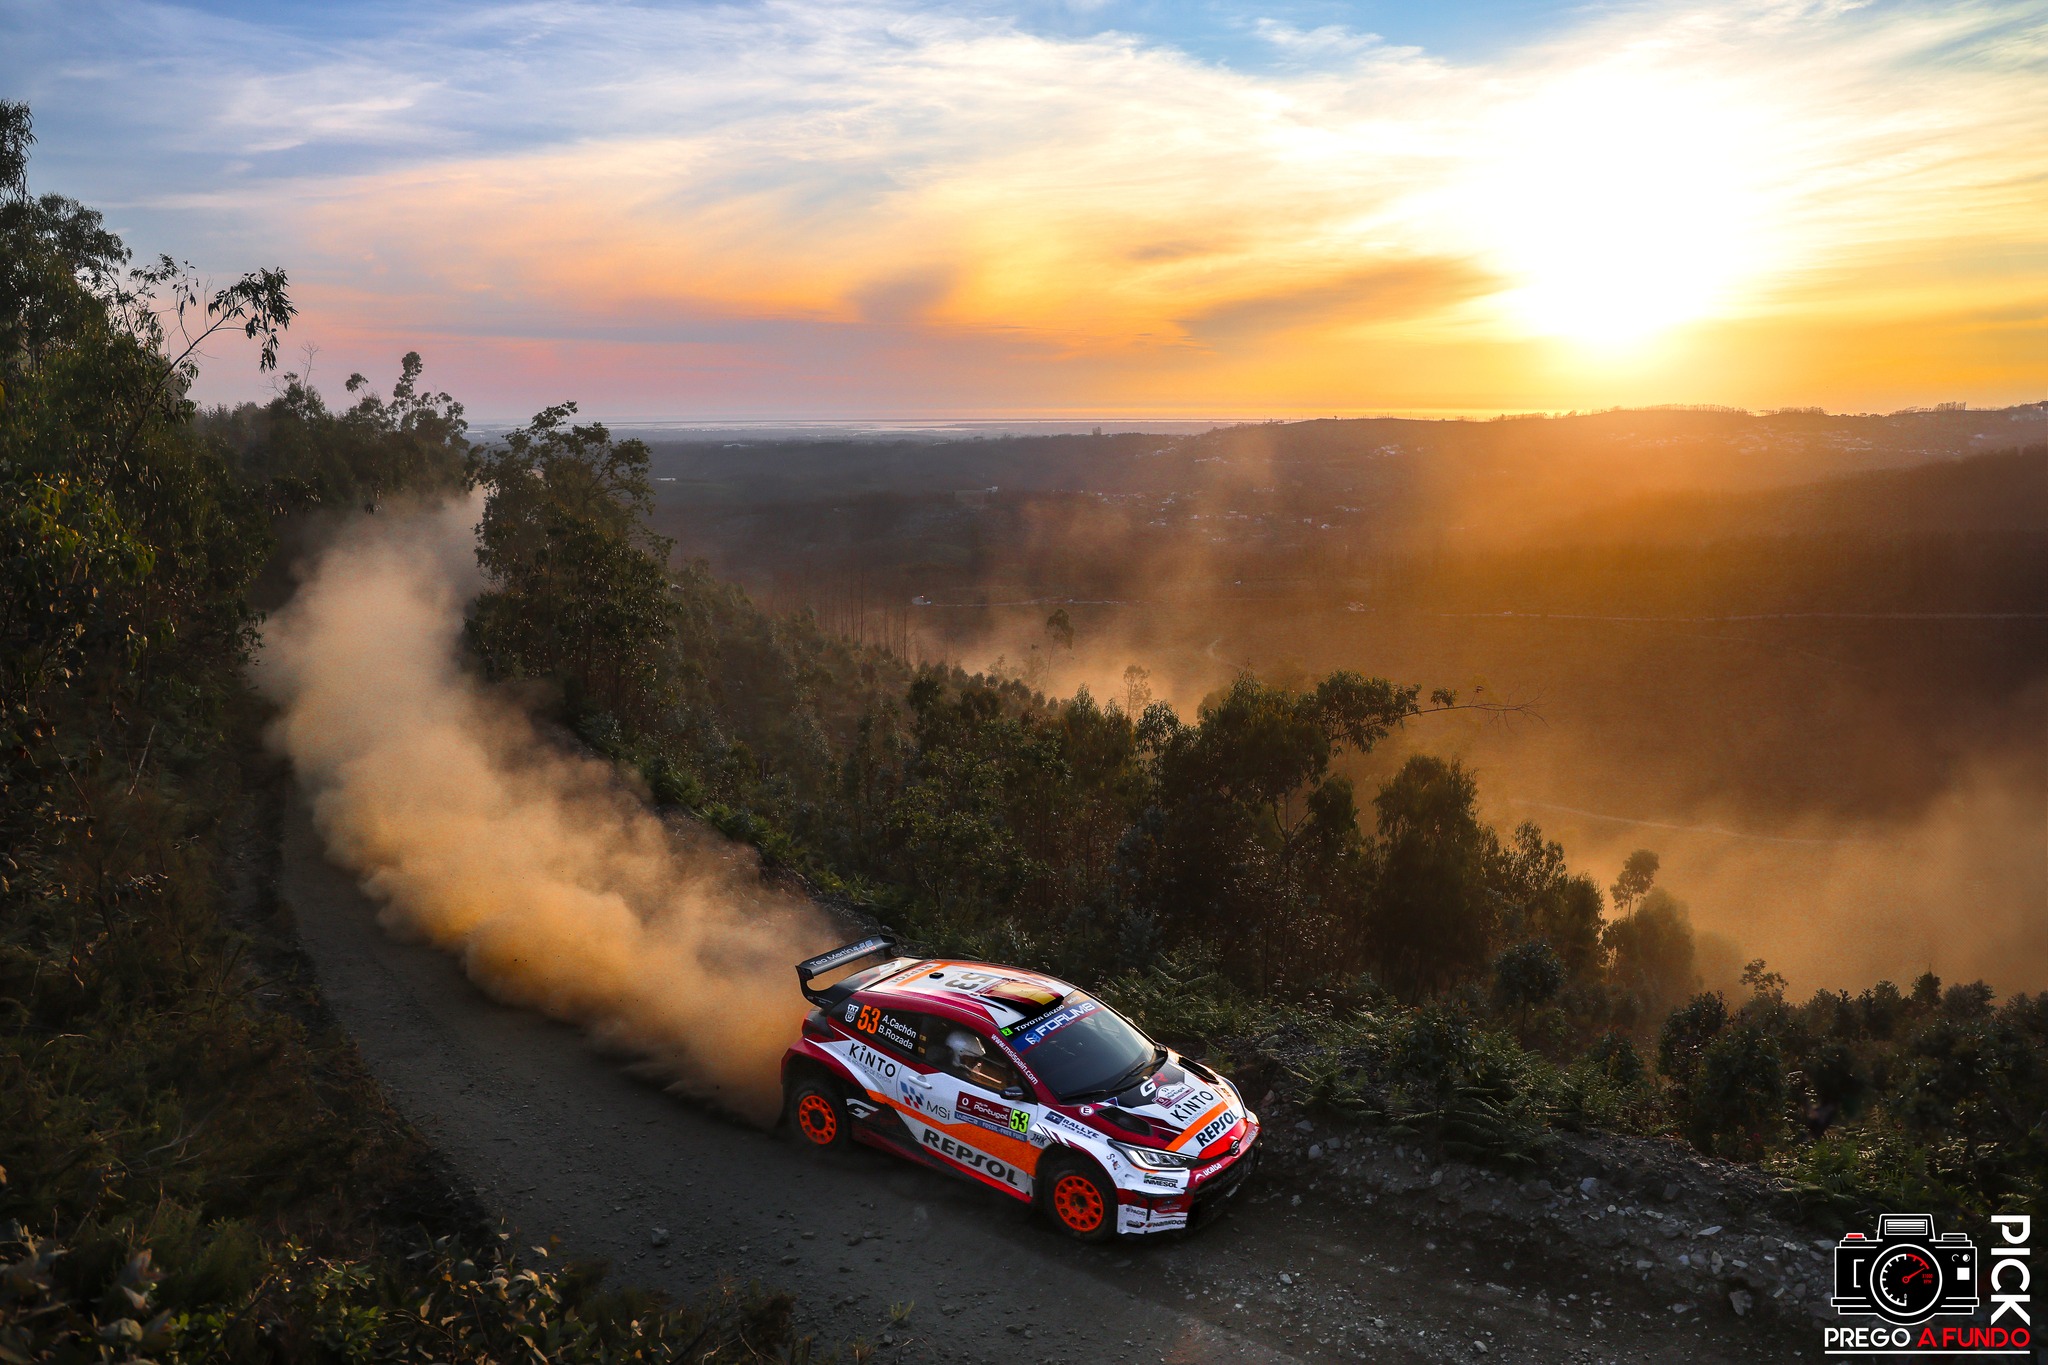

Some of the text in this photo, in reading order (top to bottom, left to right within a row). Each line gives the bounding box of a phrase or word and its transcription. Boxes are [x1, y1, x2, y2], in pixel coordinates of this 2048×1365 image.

[857, 1004, 881, 1034] 53
[881, 1014, 917, 1039] A.Cachón
[1035, 1002, 1096, 1037] FORUM8
[878, 1024, 914, 1050] B.Rozada
[991, 1033, 1039, 1085] www.msispain.com
[973, 1104, 1008, 1121] Portugal
[1010, 1109, 1029, 1133] 53
[1030, 1133, 1047, 1145] JHK
[1063, 1119, 1099, 1138] RALLYE
[1195, 1109, 1239, 1147] REPSOL
[923, 1128, 1018, 1186] REPSOL
[1203, 1162, 1222, 1176] ucalsa
[1143, 1179, 1178, 1188] INMESOL
